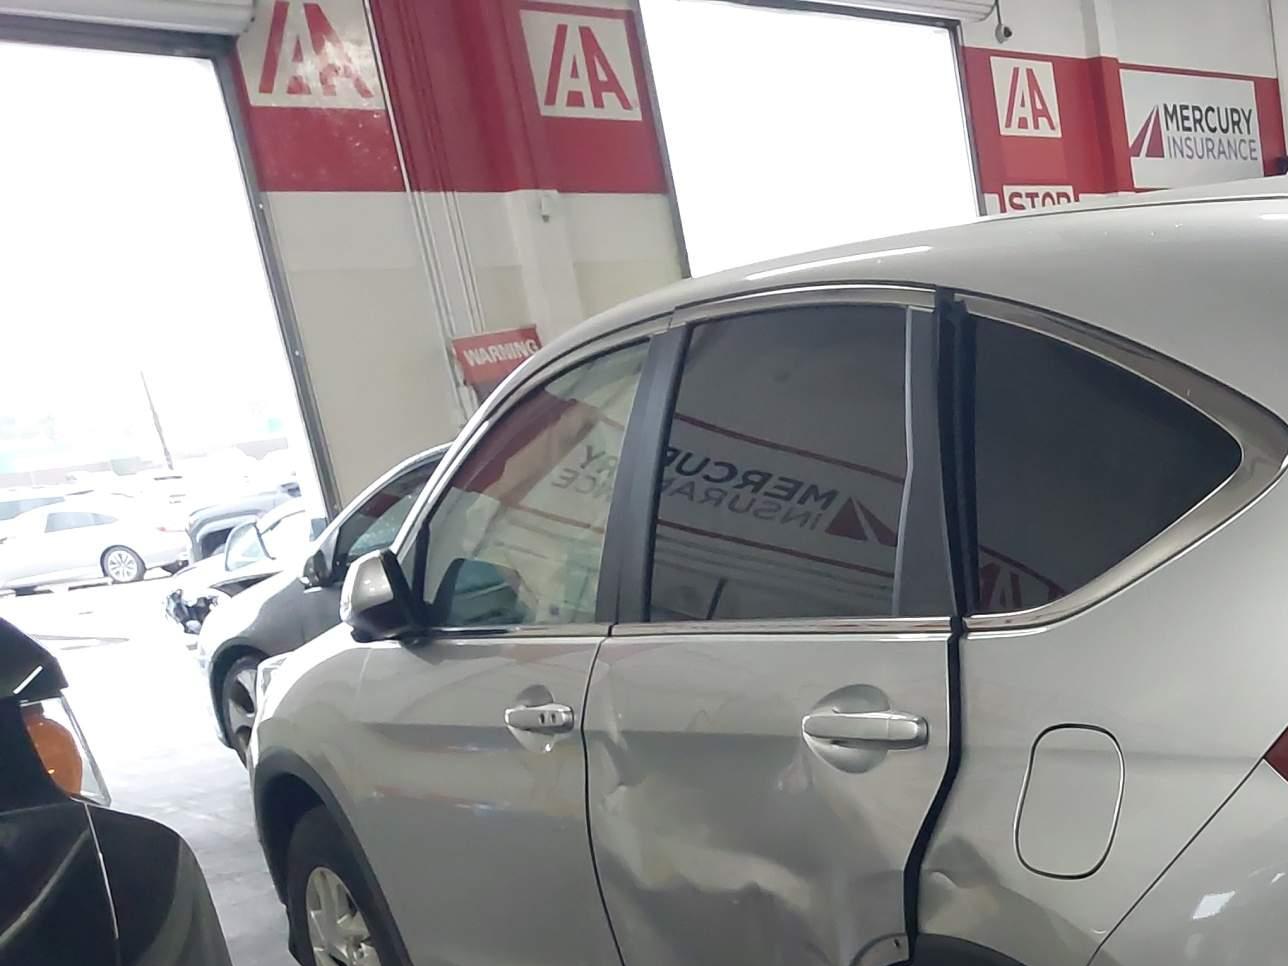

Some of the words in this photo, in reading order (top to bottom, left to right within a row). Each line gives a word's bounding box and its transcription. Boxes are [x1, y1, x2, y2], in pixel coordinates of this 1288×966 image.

[1163, 103, 1253, 135] MERCURY
[1167, 135, 1258, 161] INSURANCE
[463, 339, 539, 367] WARNING
